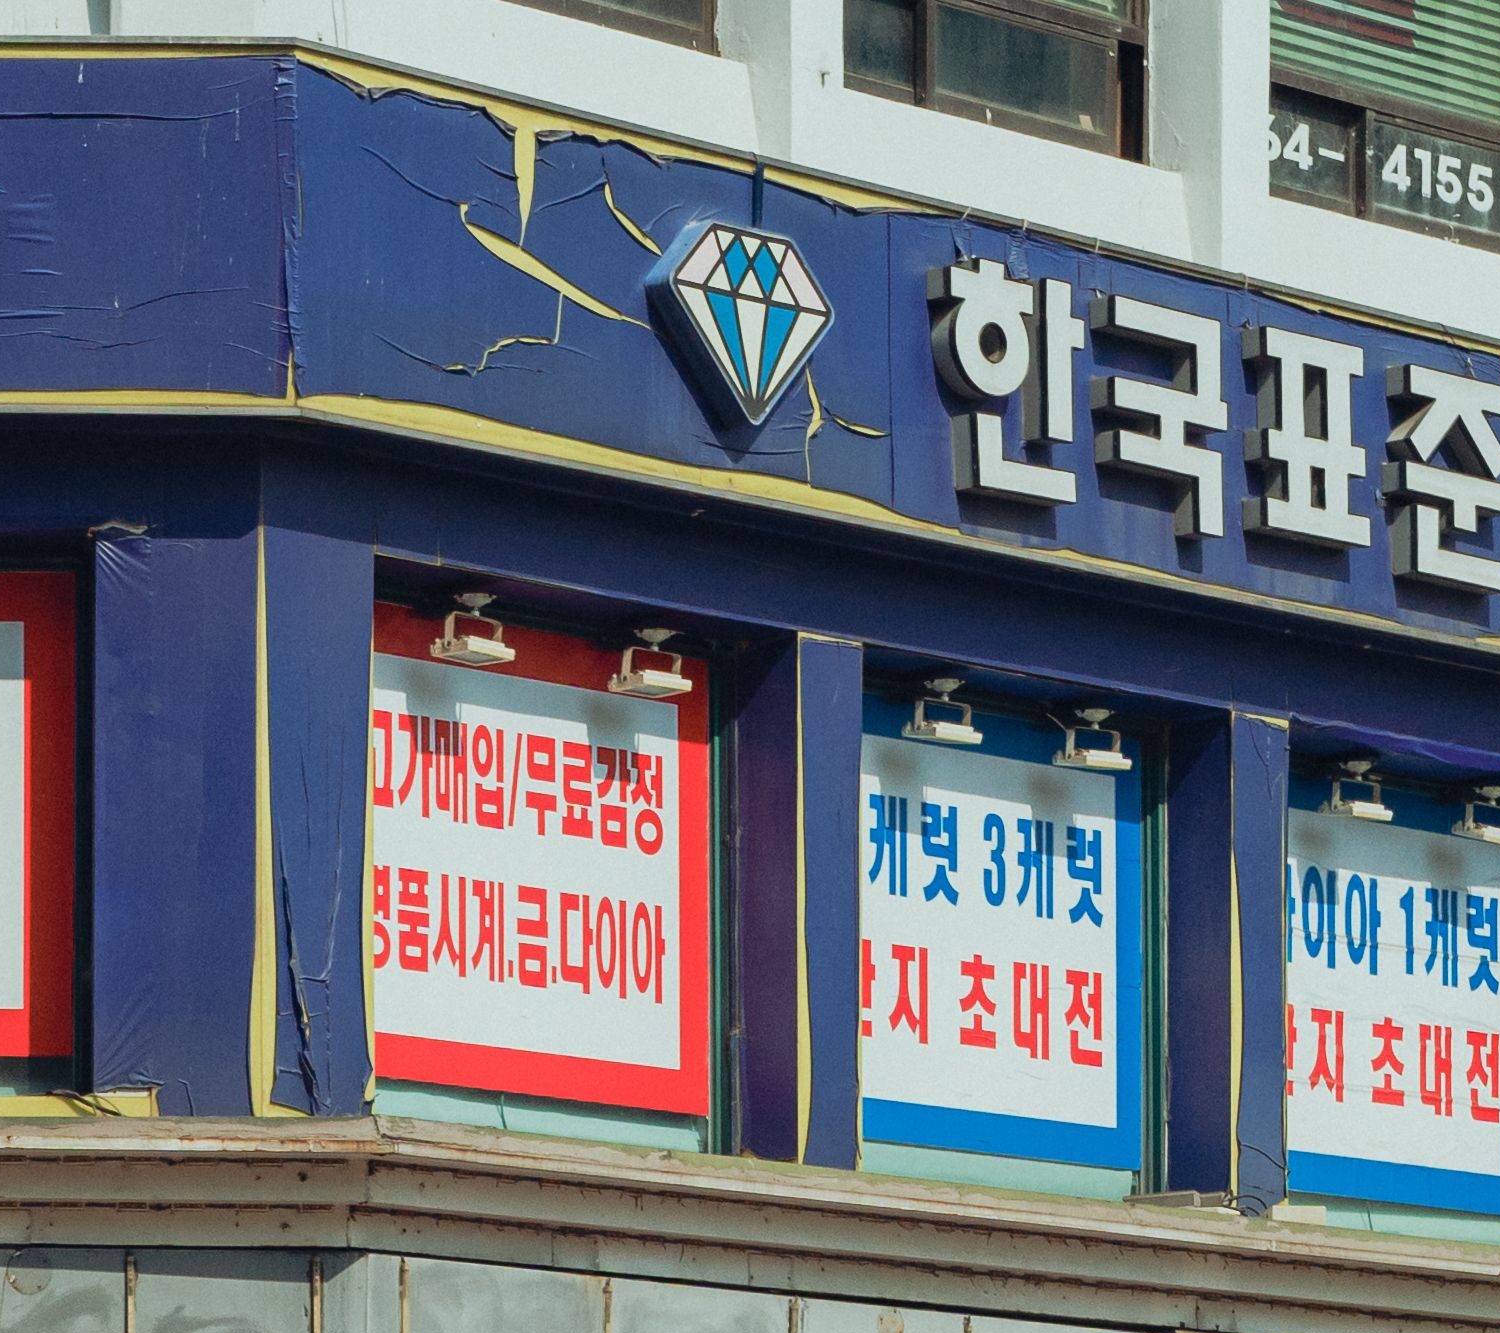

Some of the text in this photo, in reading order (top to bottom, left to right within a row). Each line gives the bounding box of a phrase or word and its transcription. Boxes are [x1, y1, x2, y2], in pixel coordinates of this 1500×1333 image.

[1381, 143, 1496, 213] 4155
[982, 813, 1104, 928] 3케럿
[1399, 871, 1500, 996] 1케럿
[959, 953, 1104, 1068] 초대전
[1370, 1016, 1500, 1124] 초대전
